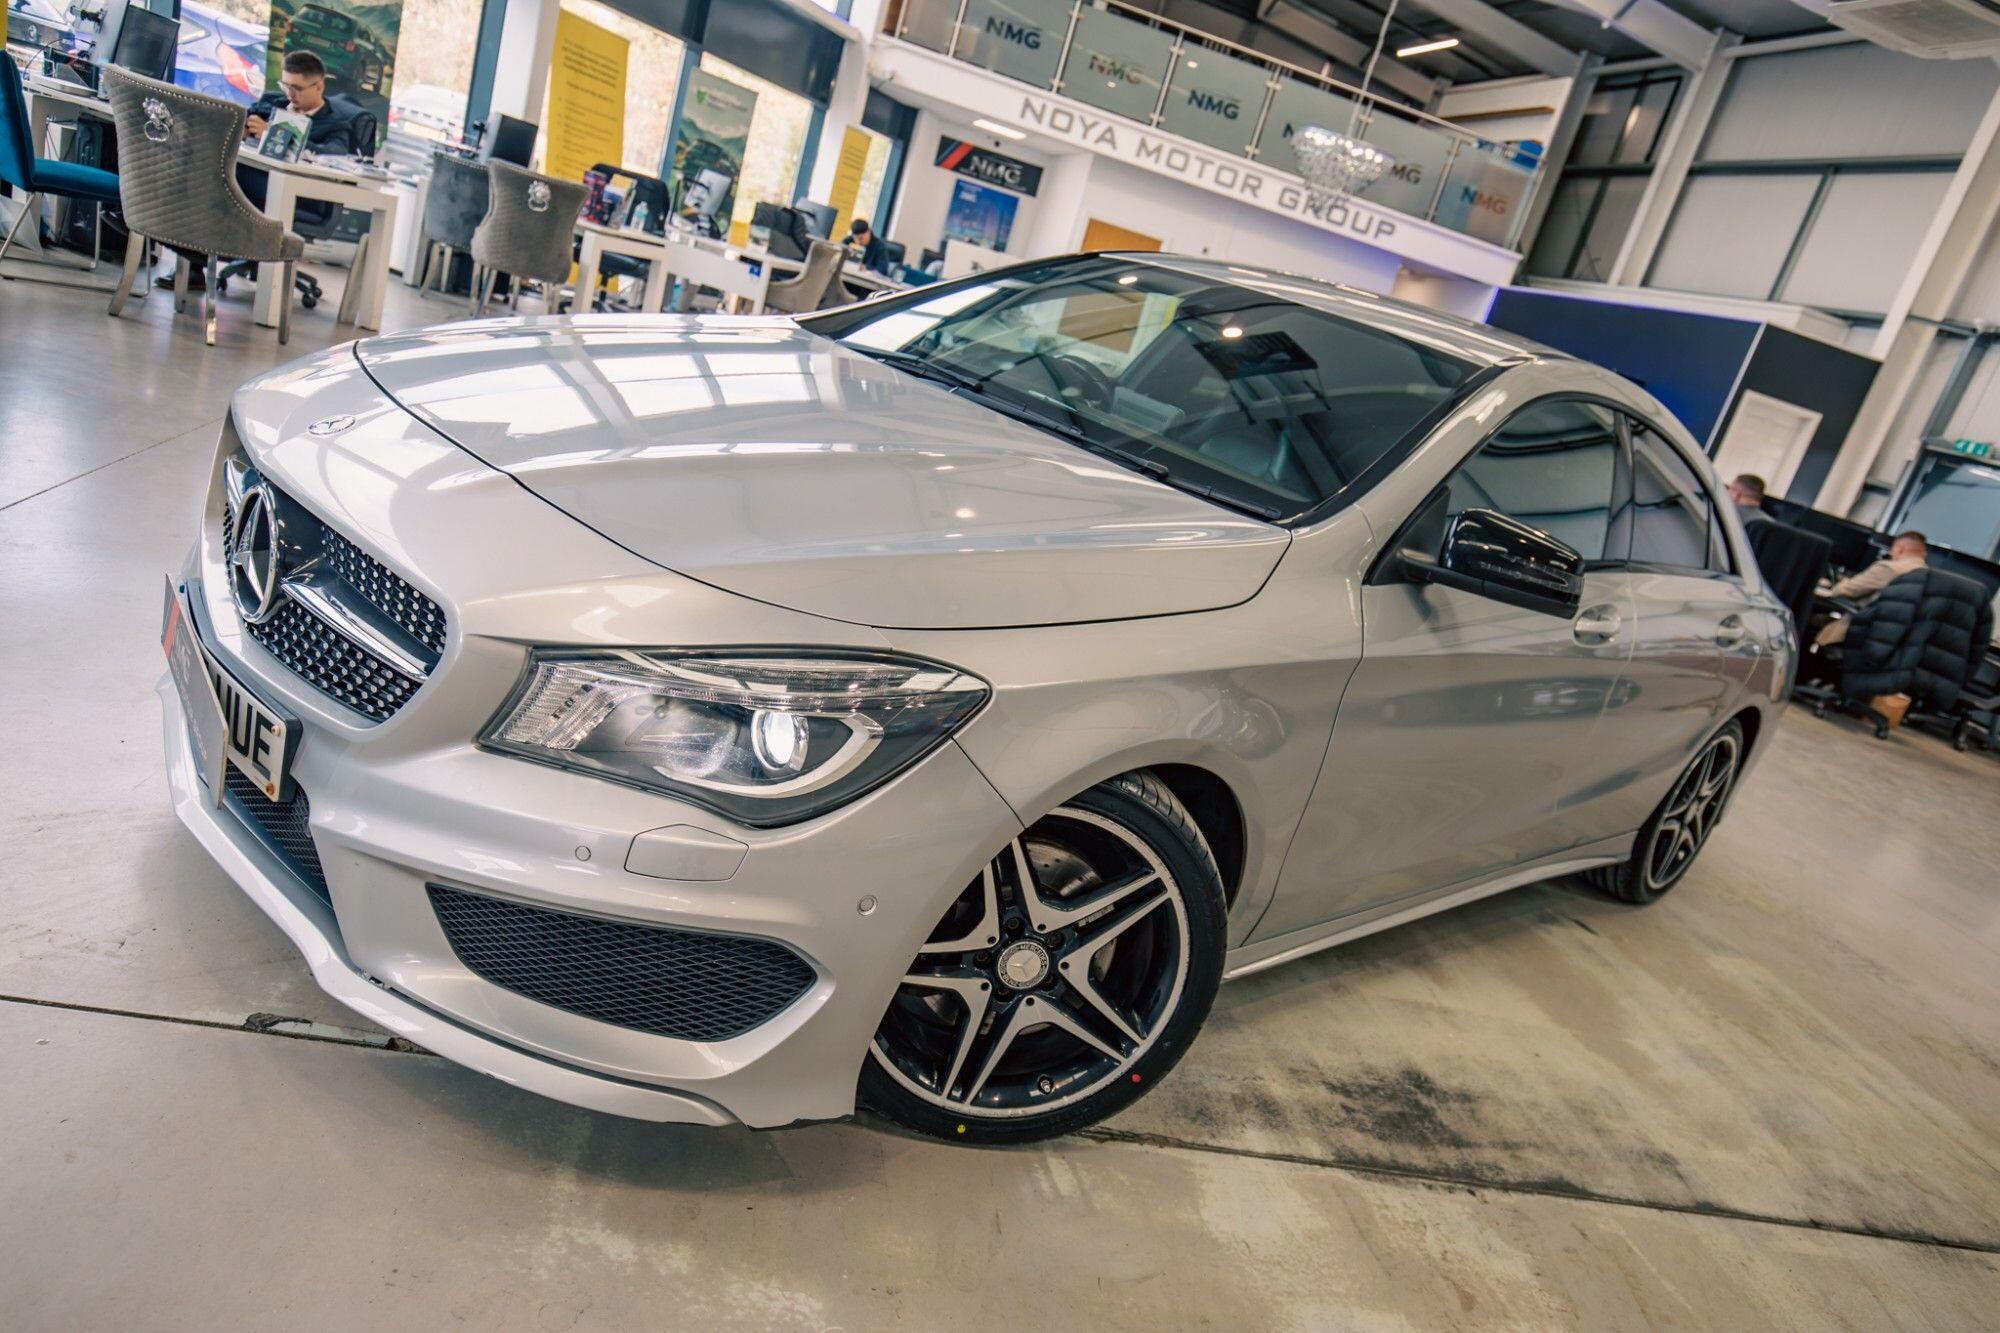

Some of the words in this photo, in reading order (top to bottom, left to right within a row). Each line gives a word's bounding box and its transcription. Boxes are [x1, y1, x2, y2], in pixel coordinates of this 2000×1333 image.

[985, 16, 1042, 50] NMG
[1187, 89, 1240, 120] NMG
[969, 154, 1022, 184] NMG
[1020, 97, 1117, 150] NOYA
[1135, 136, 1262, 199] MOTOR
[1278, 187, 1396, 239] GROUP
[1460, 185, 1506, 215] NMG
